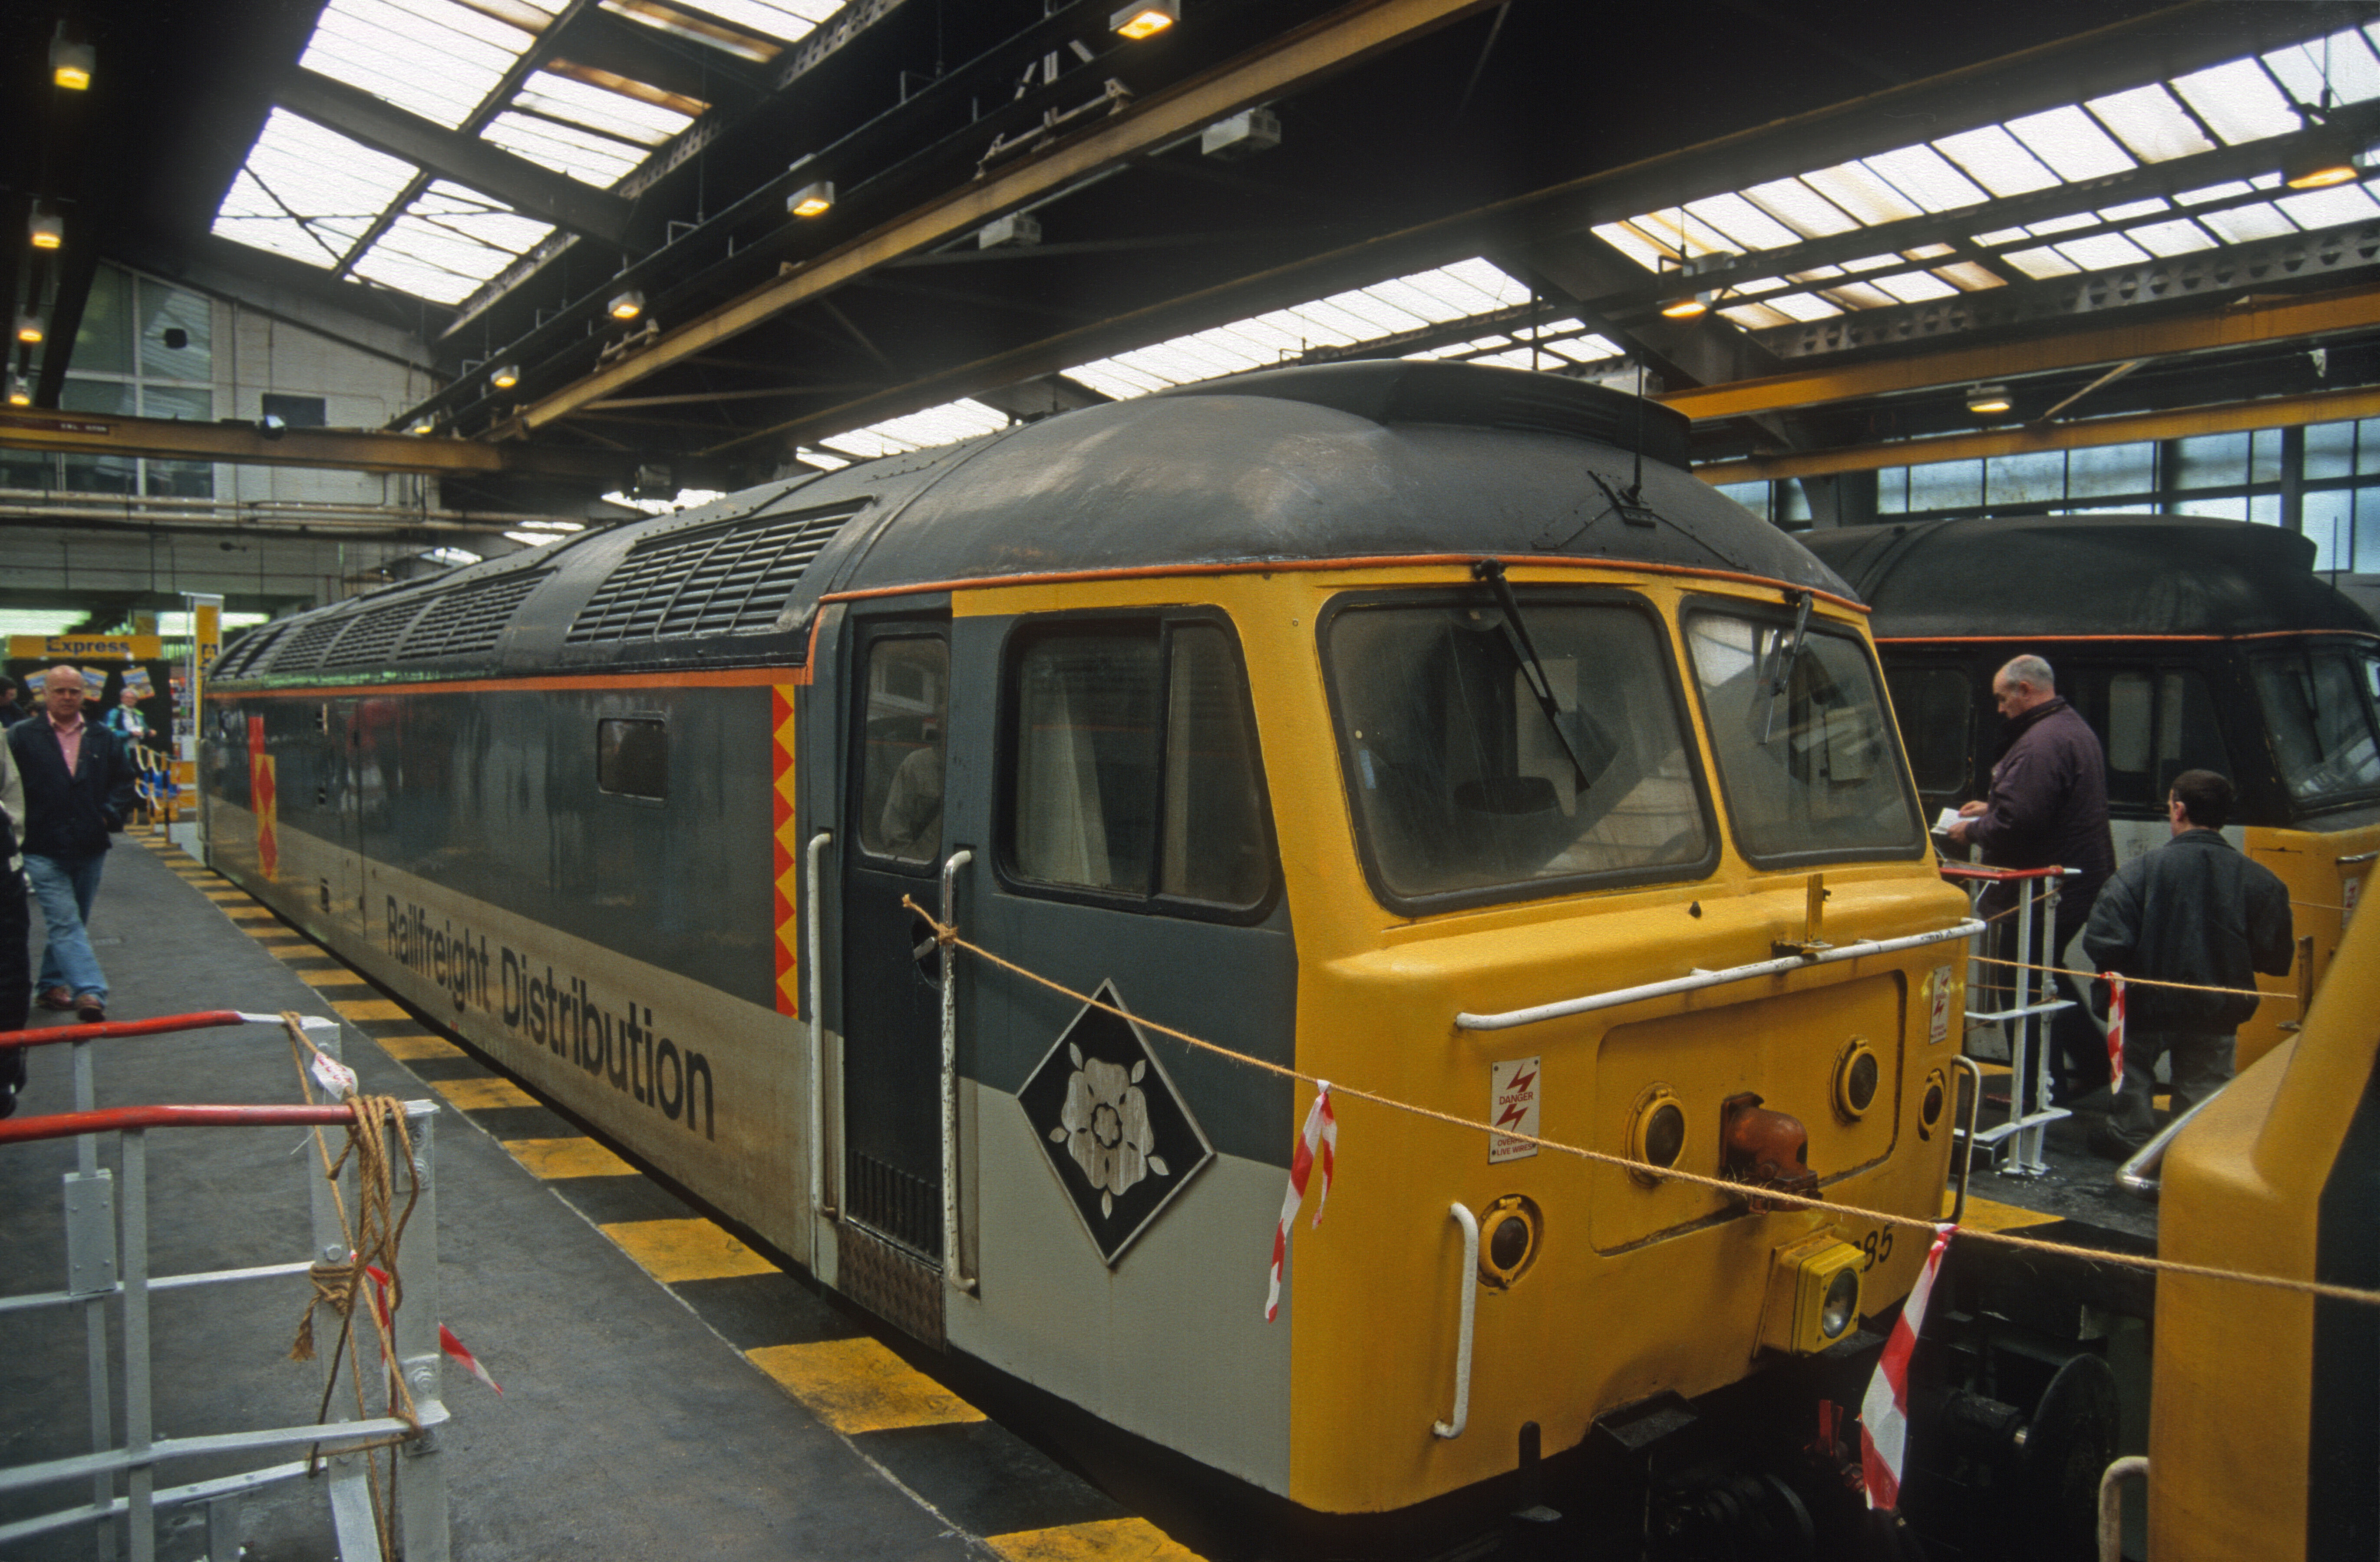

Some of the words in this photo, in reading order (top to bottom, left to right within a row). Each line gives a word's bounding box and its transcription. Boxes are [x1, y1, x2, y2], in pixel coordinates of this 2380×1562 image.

[46, 637, 129, 655] Express
[387, 895, 491, 1014] Railfreight
[501, 946, 714, 1143] Distribution
[1499, 1092, 1534, 1105] DANGER
[1497, 1147, 1511, 1156] LIVE
[1512, 1143, 1532, 1153] WIRES
[1852, 1222, 1896, 1272] 85
